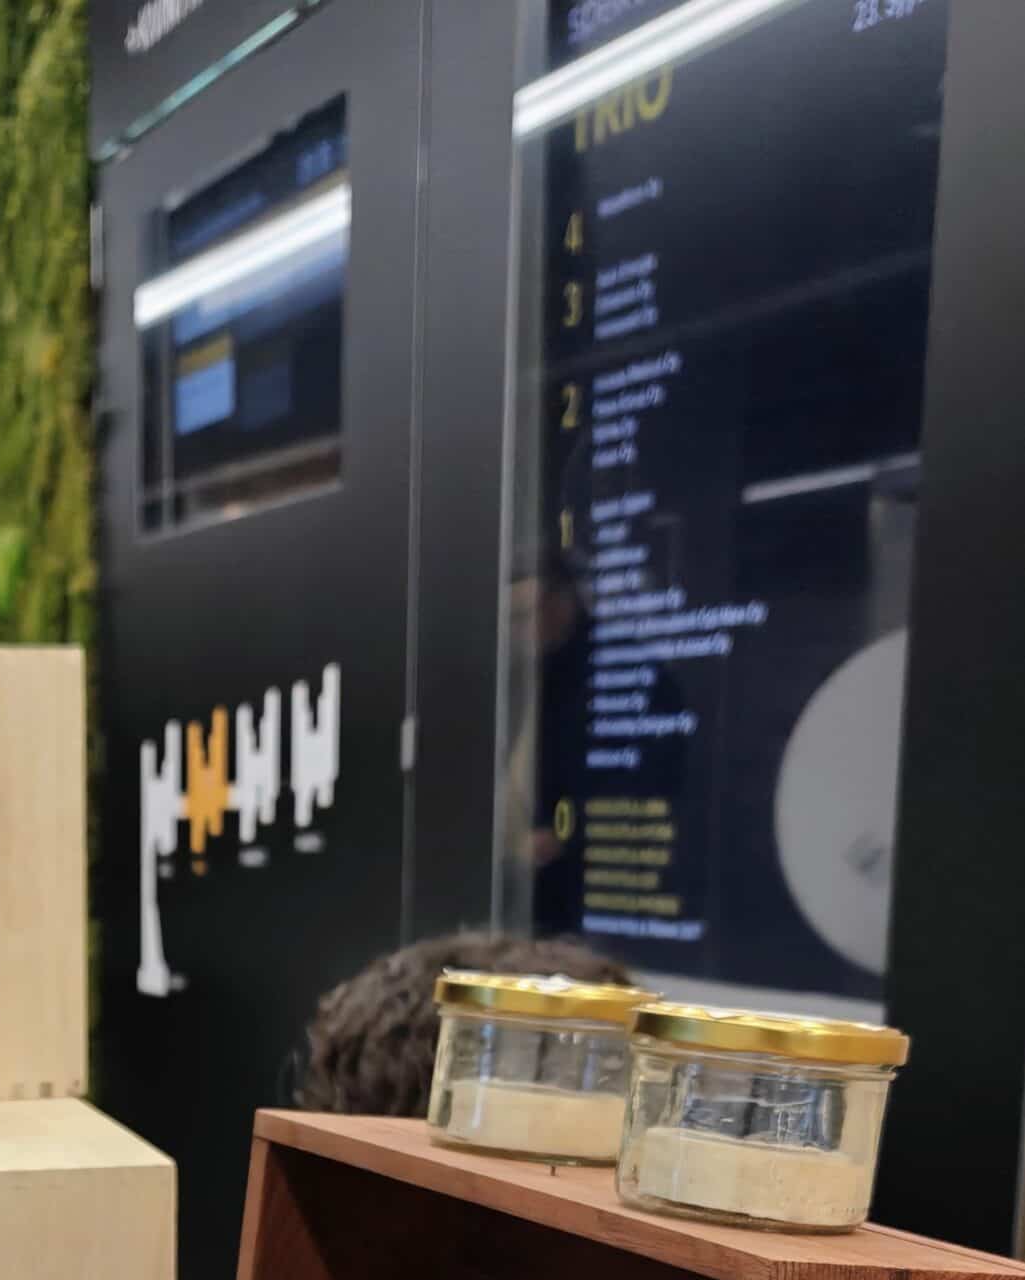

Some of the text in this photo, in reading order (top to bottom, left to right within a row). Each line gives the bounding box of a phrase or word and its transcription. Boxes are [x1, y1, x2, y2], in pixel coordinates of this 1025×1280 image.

[574, 63, 674, 153] TRIO
[564, 211, 583, 252] 4
[563, 282, 582, 327] 3
[560, 383, 578, 429] 2
[559, 508, 573, 549] 1
[553, 799, 571, 841] 0
